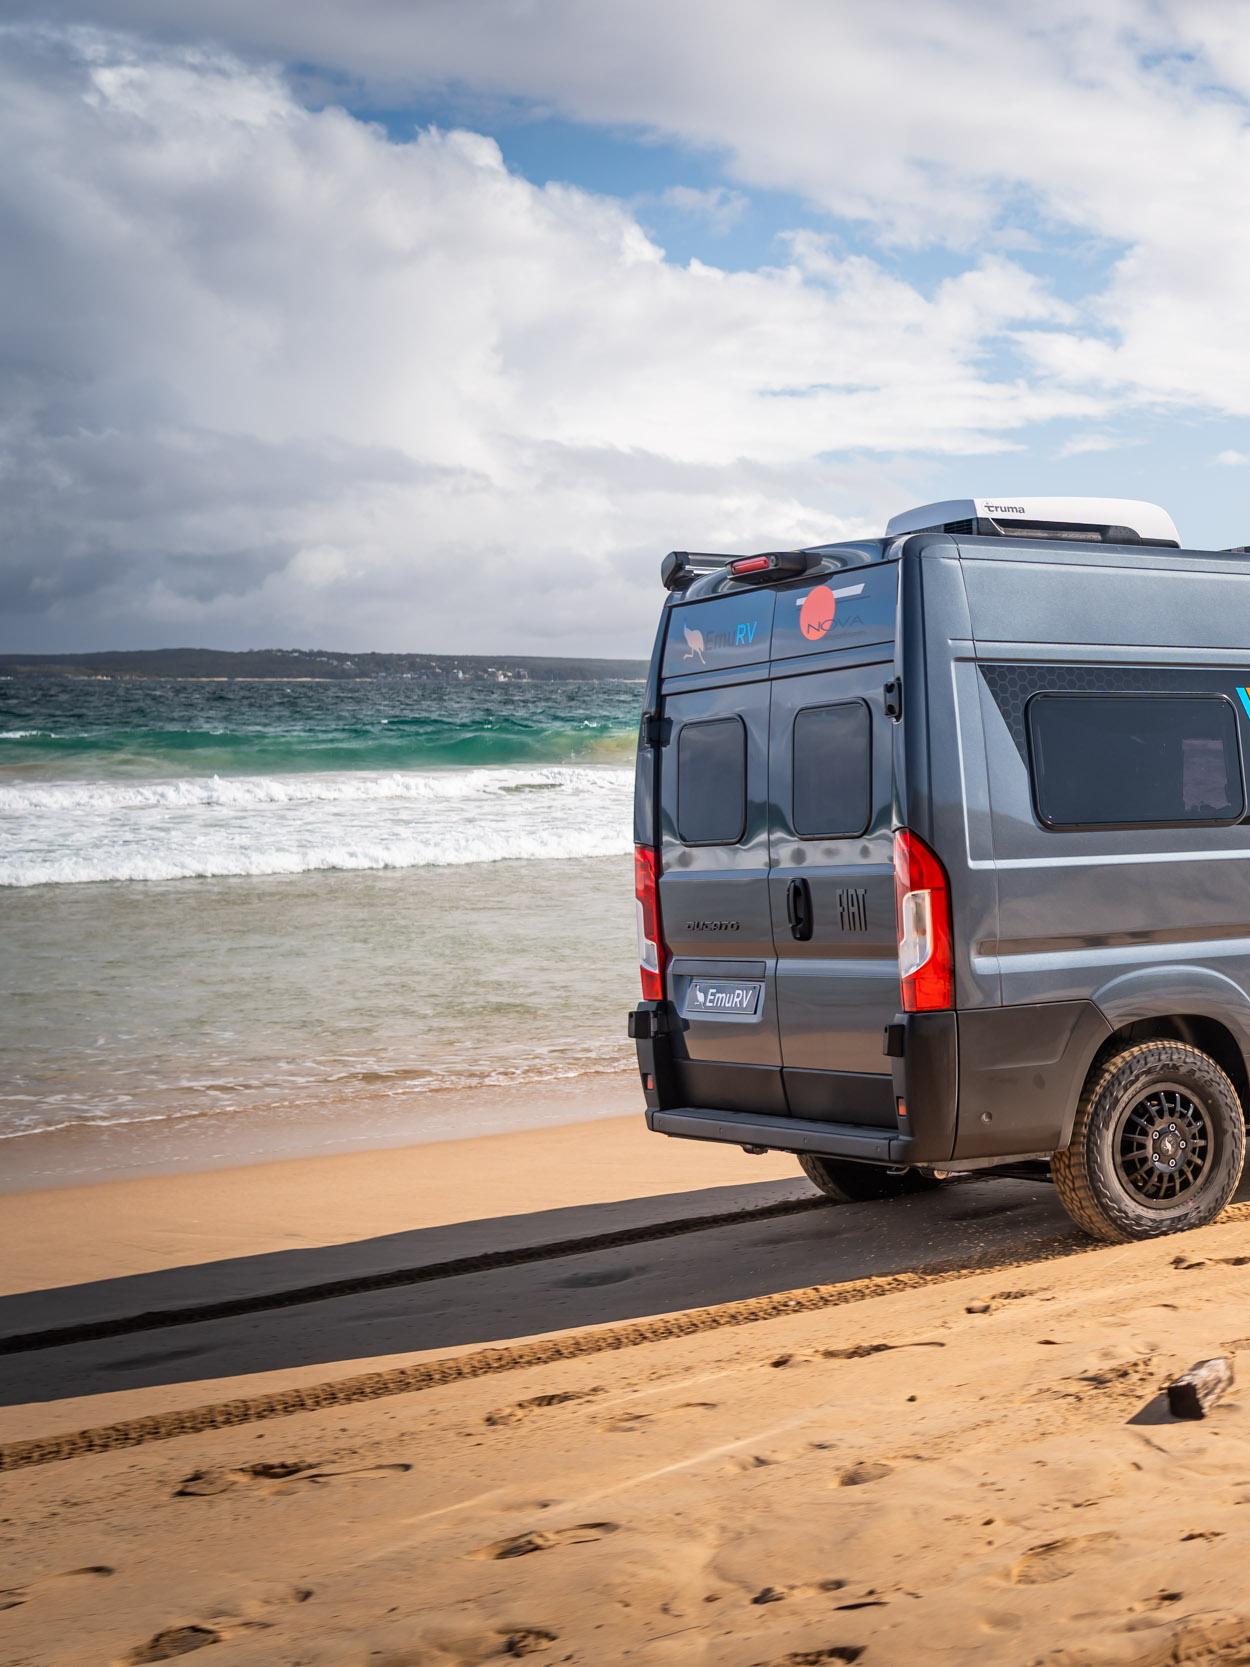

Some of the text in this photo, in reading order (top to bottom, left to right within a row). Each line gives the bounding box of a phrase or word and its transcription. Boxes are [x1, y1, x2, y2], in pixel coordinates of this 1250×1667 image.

[984, 502, 1026, 514] truma
[807, 615, 865, 635] NOVA
[835, 888, 868, 932] FIAT
[686, 920, 741, 932] DUCATO
[705, 988, 753, 1008] EmuRV
